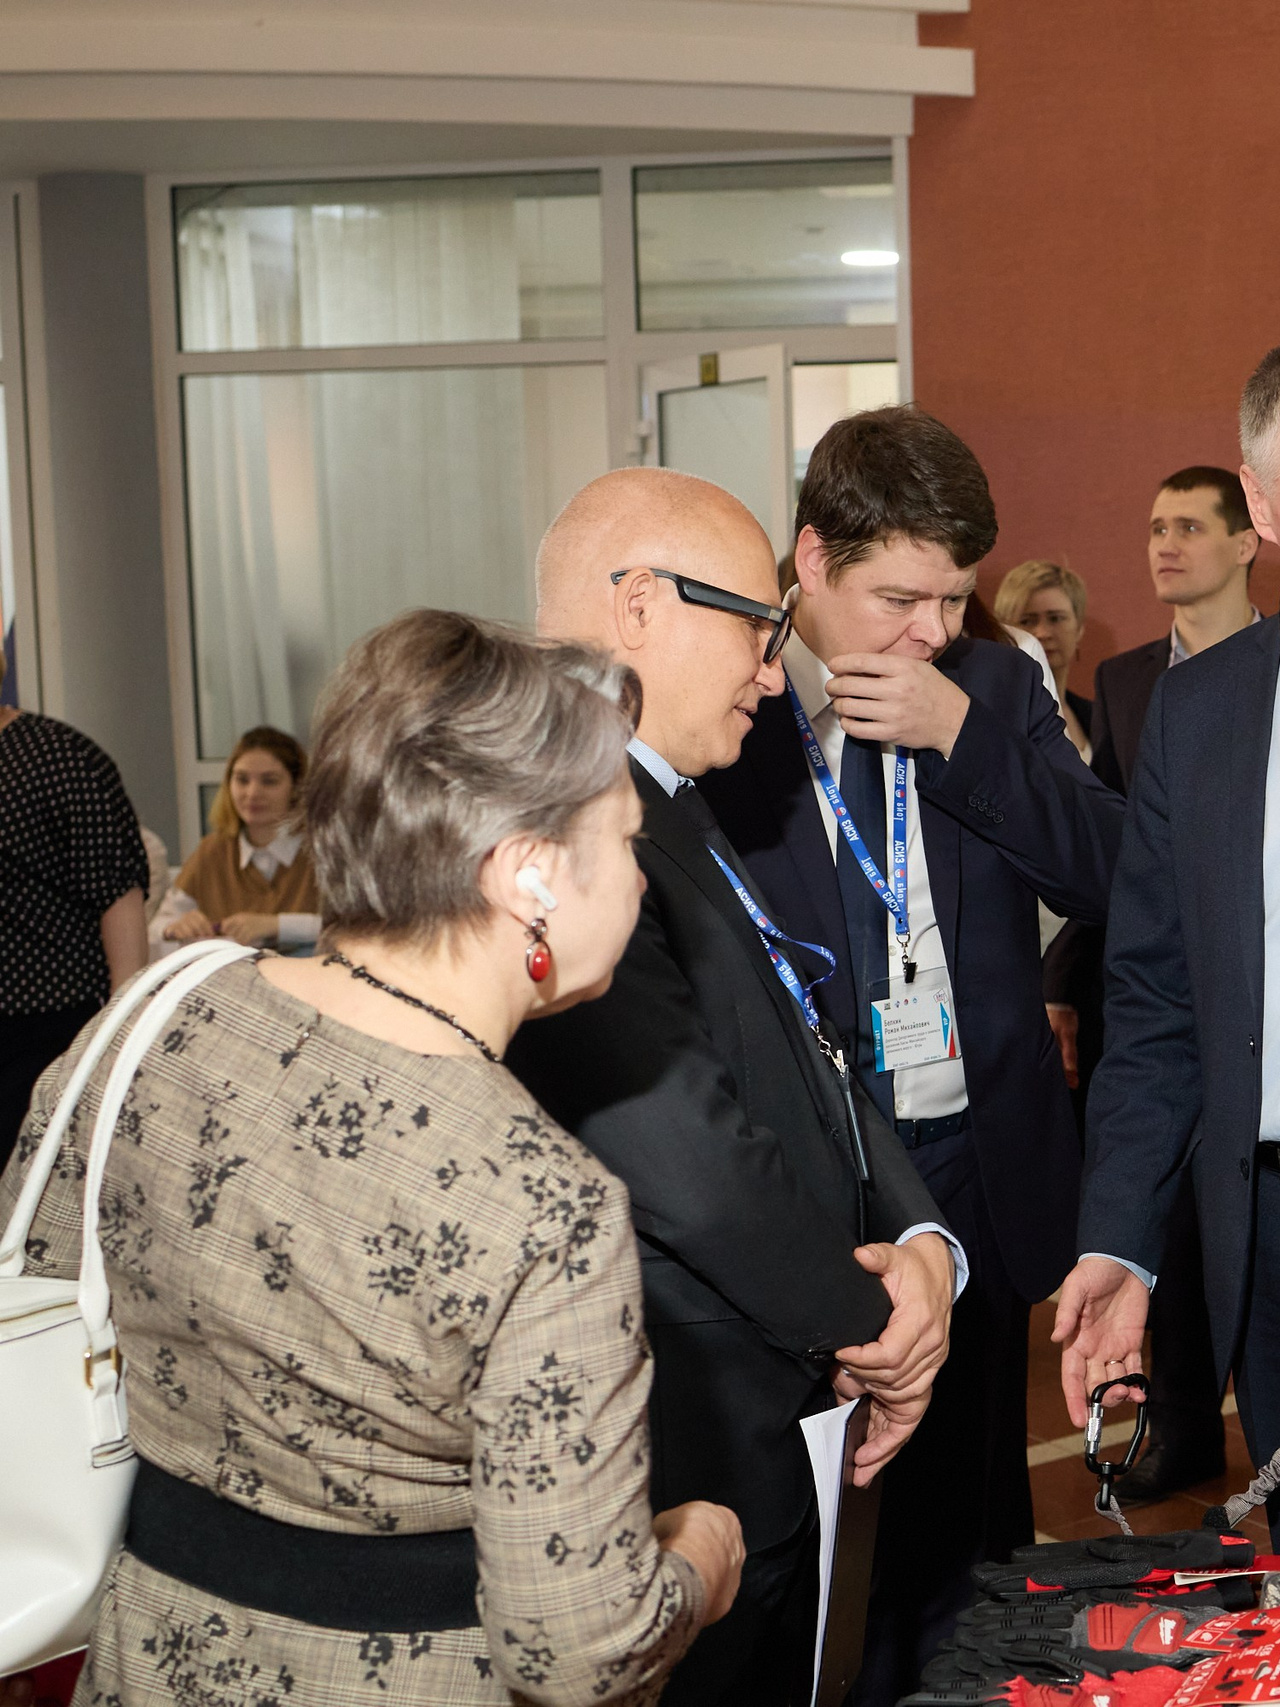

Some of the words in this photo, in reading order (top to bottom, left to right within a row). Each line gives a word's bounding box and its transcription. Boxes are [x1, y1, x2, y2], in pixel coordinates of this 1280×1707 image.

[794, 709, 808, 730] БИОТ
[808, 744, 825, 767] АСИЗ
[896, 762, 906, 785] АСИЗ
[825, 783, 840, 805] БИОТ
[893, 802, 907, 821] БИОТ
[841, 818, 859, 842] АСИЗ
[894, 839, 905, 864] АСИЗ
[861, 856, 877, 878] БИОТ
[735, 887, 757, 915] АСИЗ
[882, 891, 901, 912] АСИЗ
[778, 964, 798, 988] БИОТ
